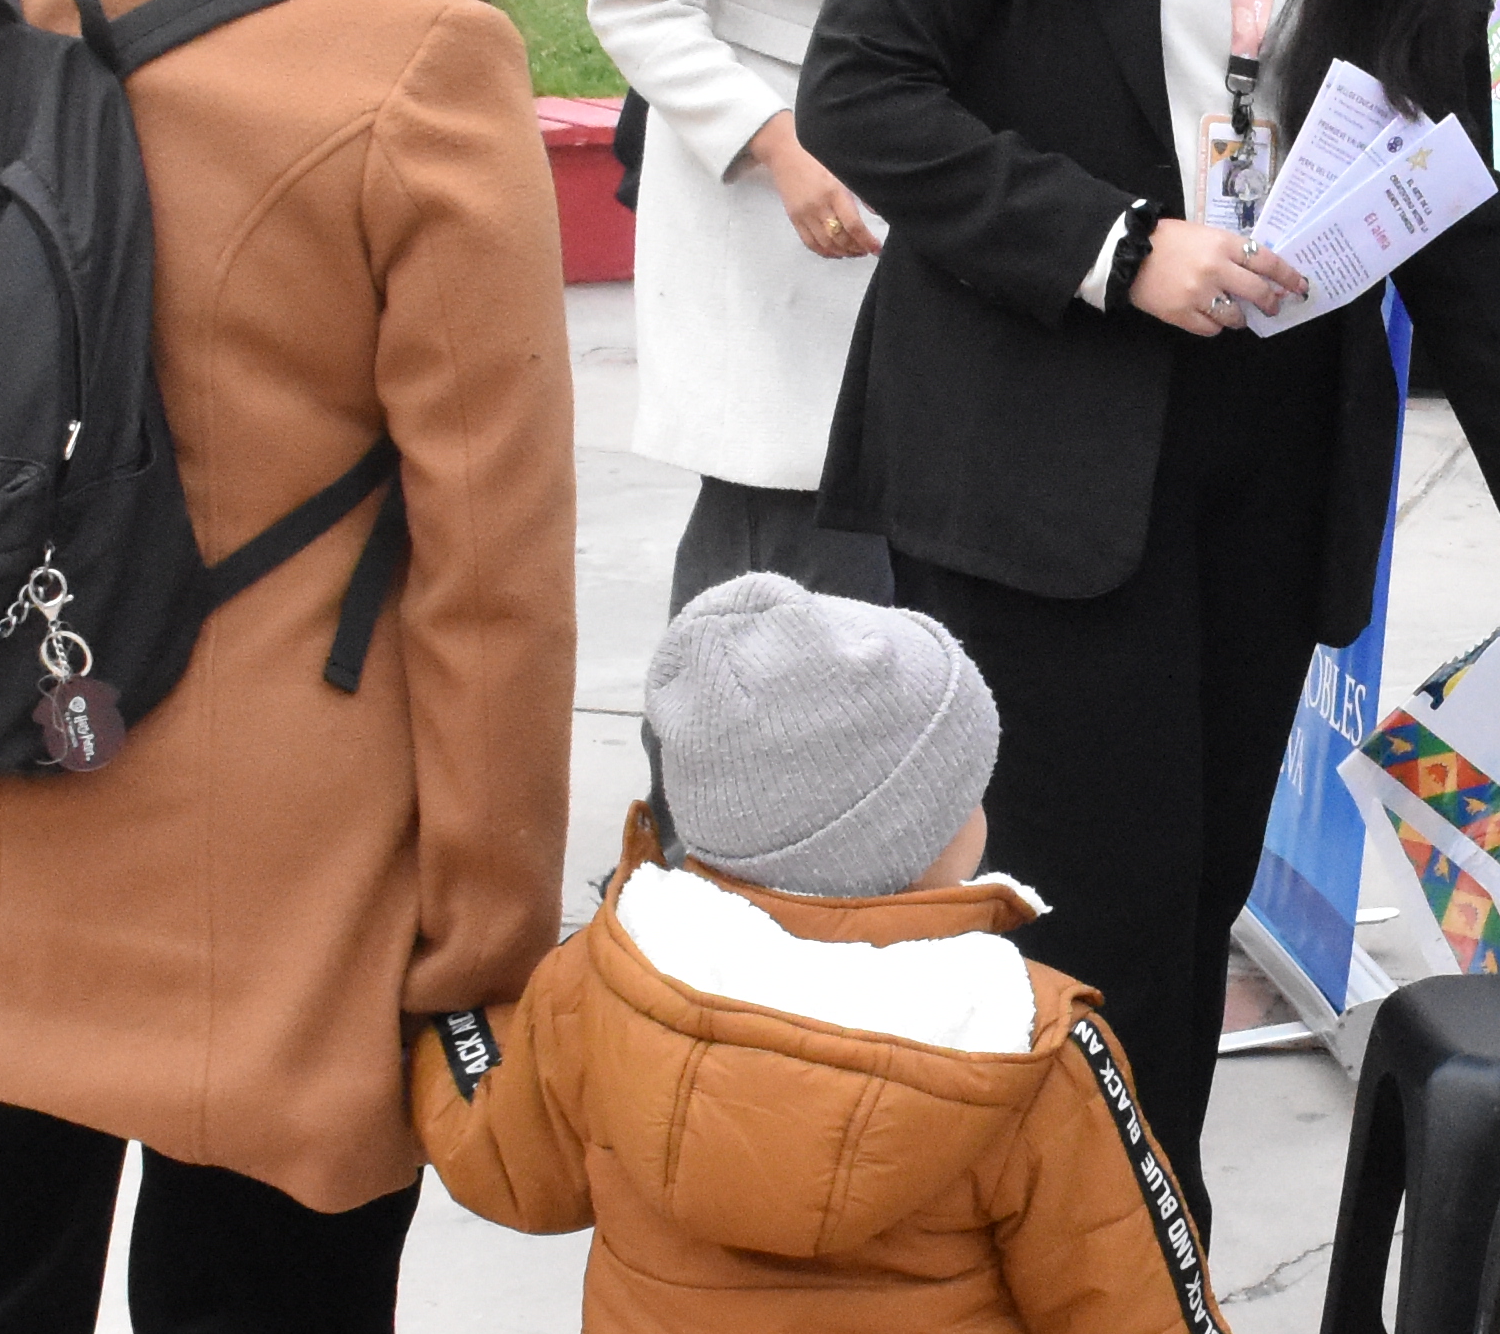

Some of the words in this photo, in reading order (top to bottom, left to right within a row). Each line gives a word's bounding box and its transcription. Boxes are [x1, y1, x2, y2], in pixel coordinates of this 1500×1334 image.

[1304, 648, 1366, 747] OBLES
[1098, 1057, 1142, 1146] BLACK
[1139, 1151, 1179, 1221] BLUE
[1168, 1216, 1197, 1272] AND
